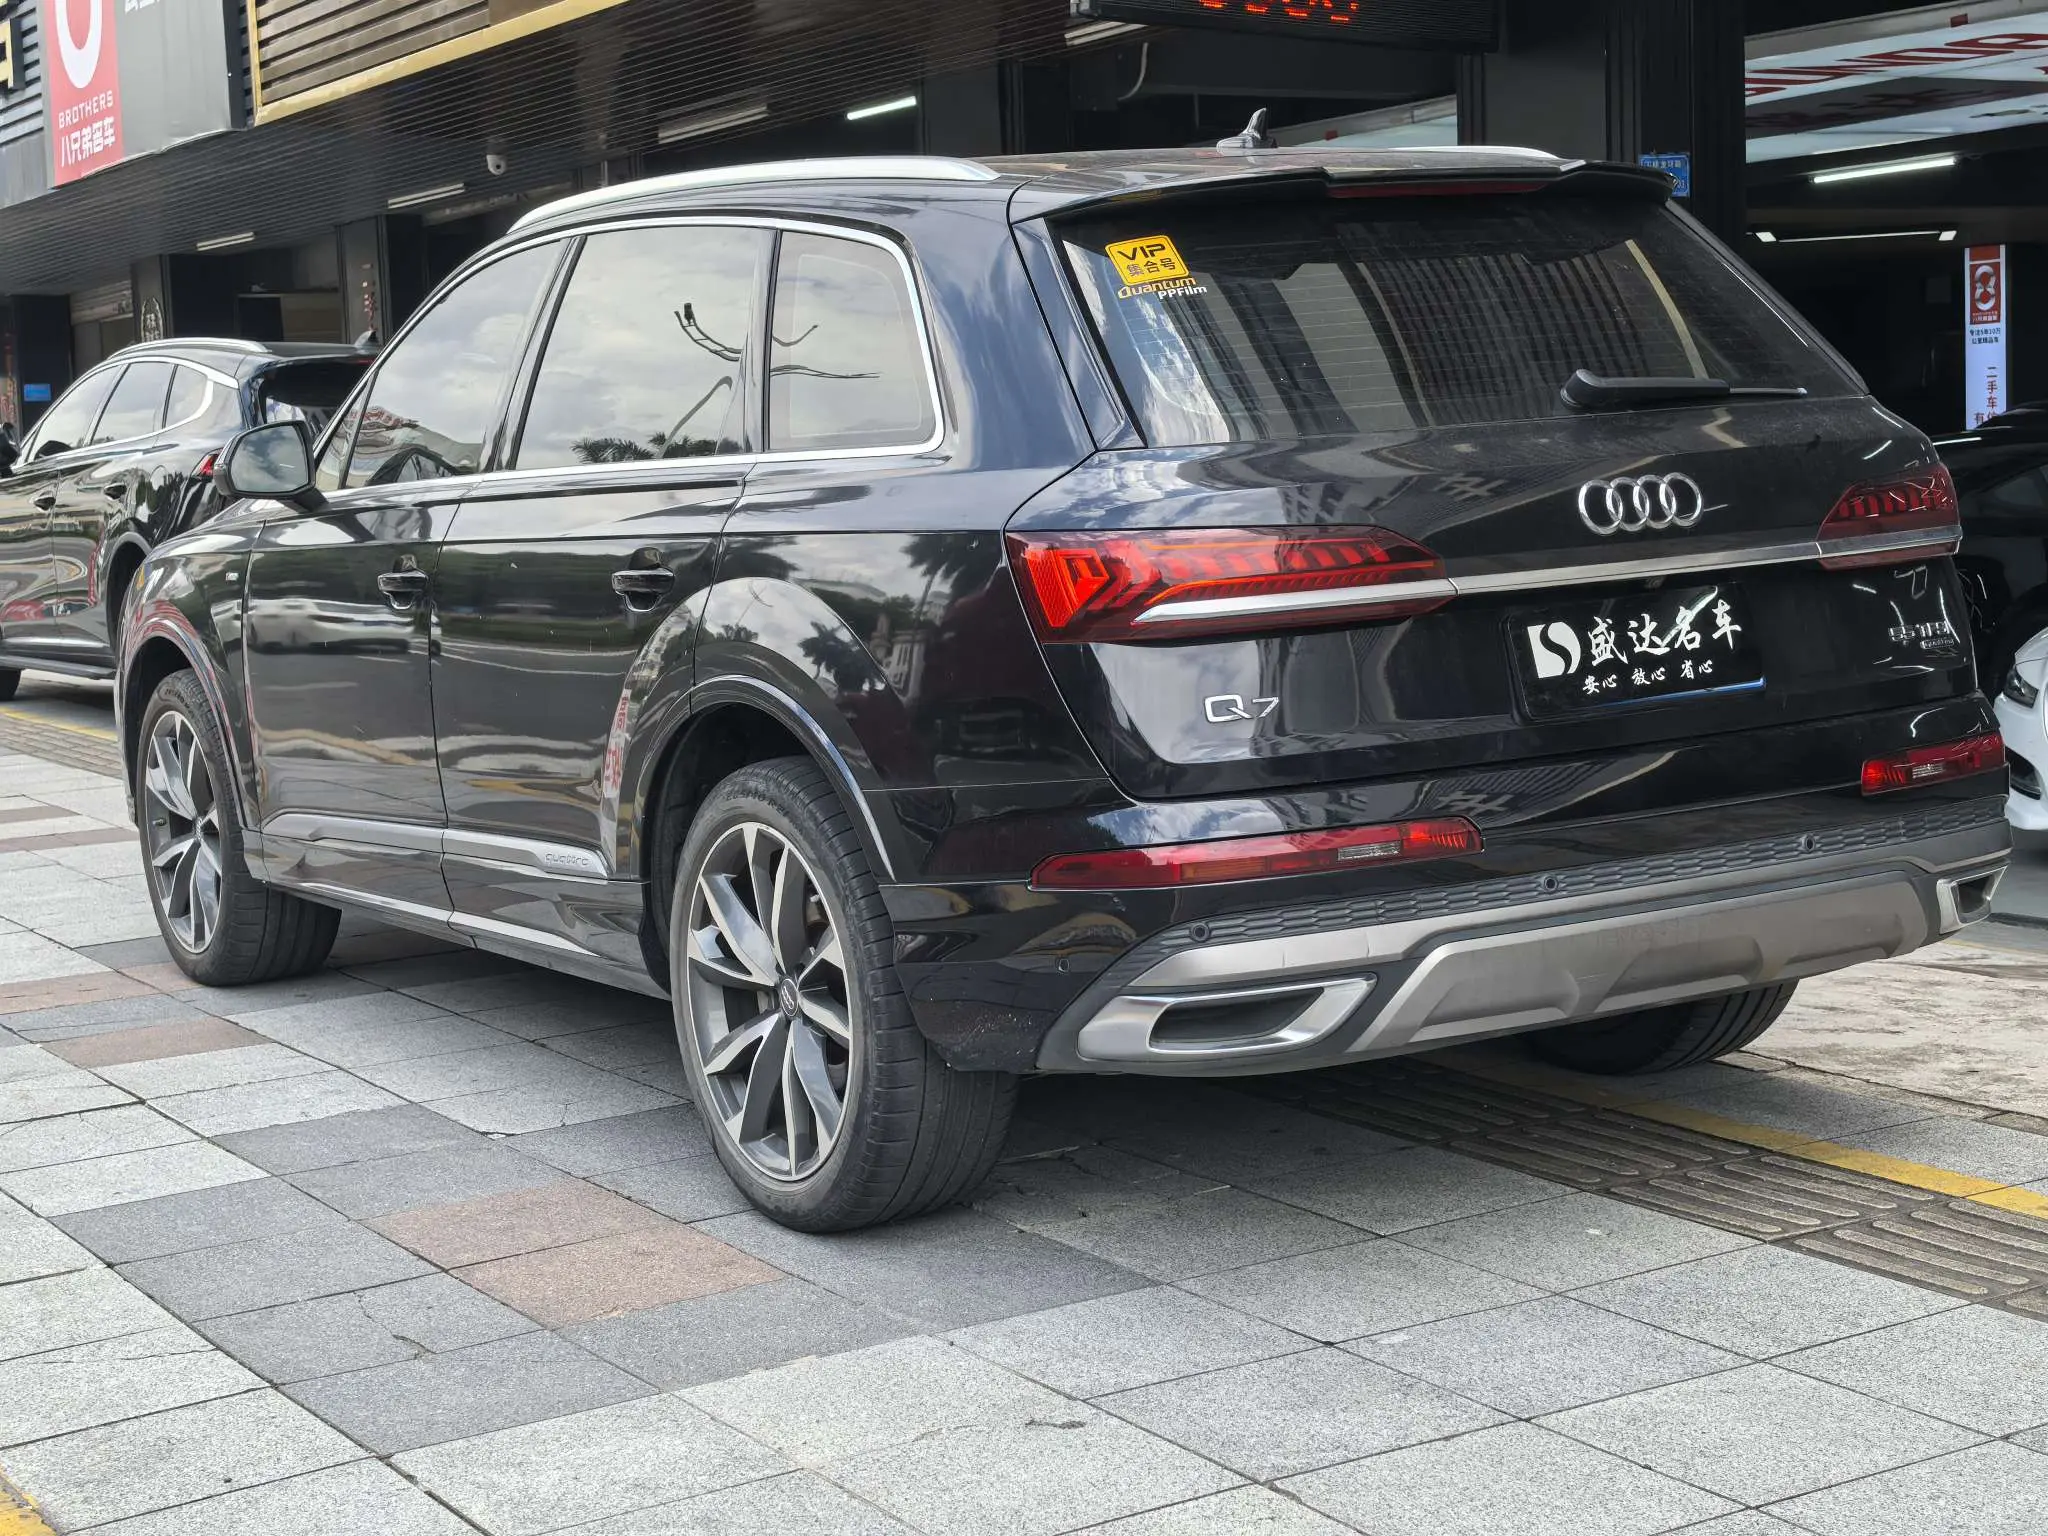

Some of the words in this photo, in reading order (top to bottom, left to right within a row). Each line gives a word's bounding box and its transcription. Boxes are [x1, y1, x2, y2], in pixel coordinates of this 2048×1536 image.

[58, 90, 114, 129] BROTHERS
[1117, 244, 1166, 261] VIP
[1587, 588, 1742, 667] 盛达名车
[1582, 675, 1618, 694] 安心
[1631, 667, 1666, 685] 放心
[1680, 659, 1713, 679] 省心
[1204, 694, 1280, 722] Q7
[545, 853, 590, 866] quattro
